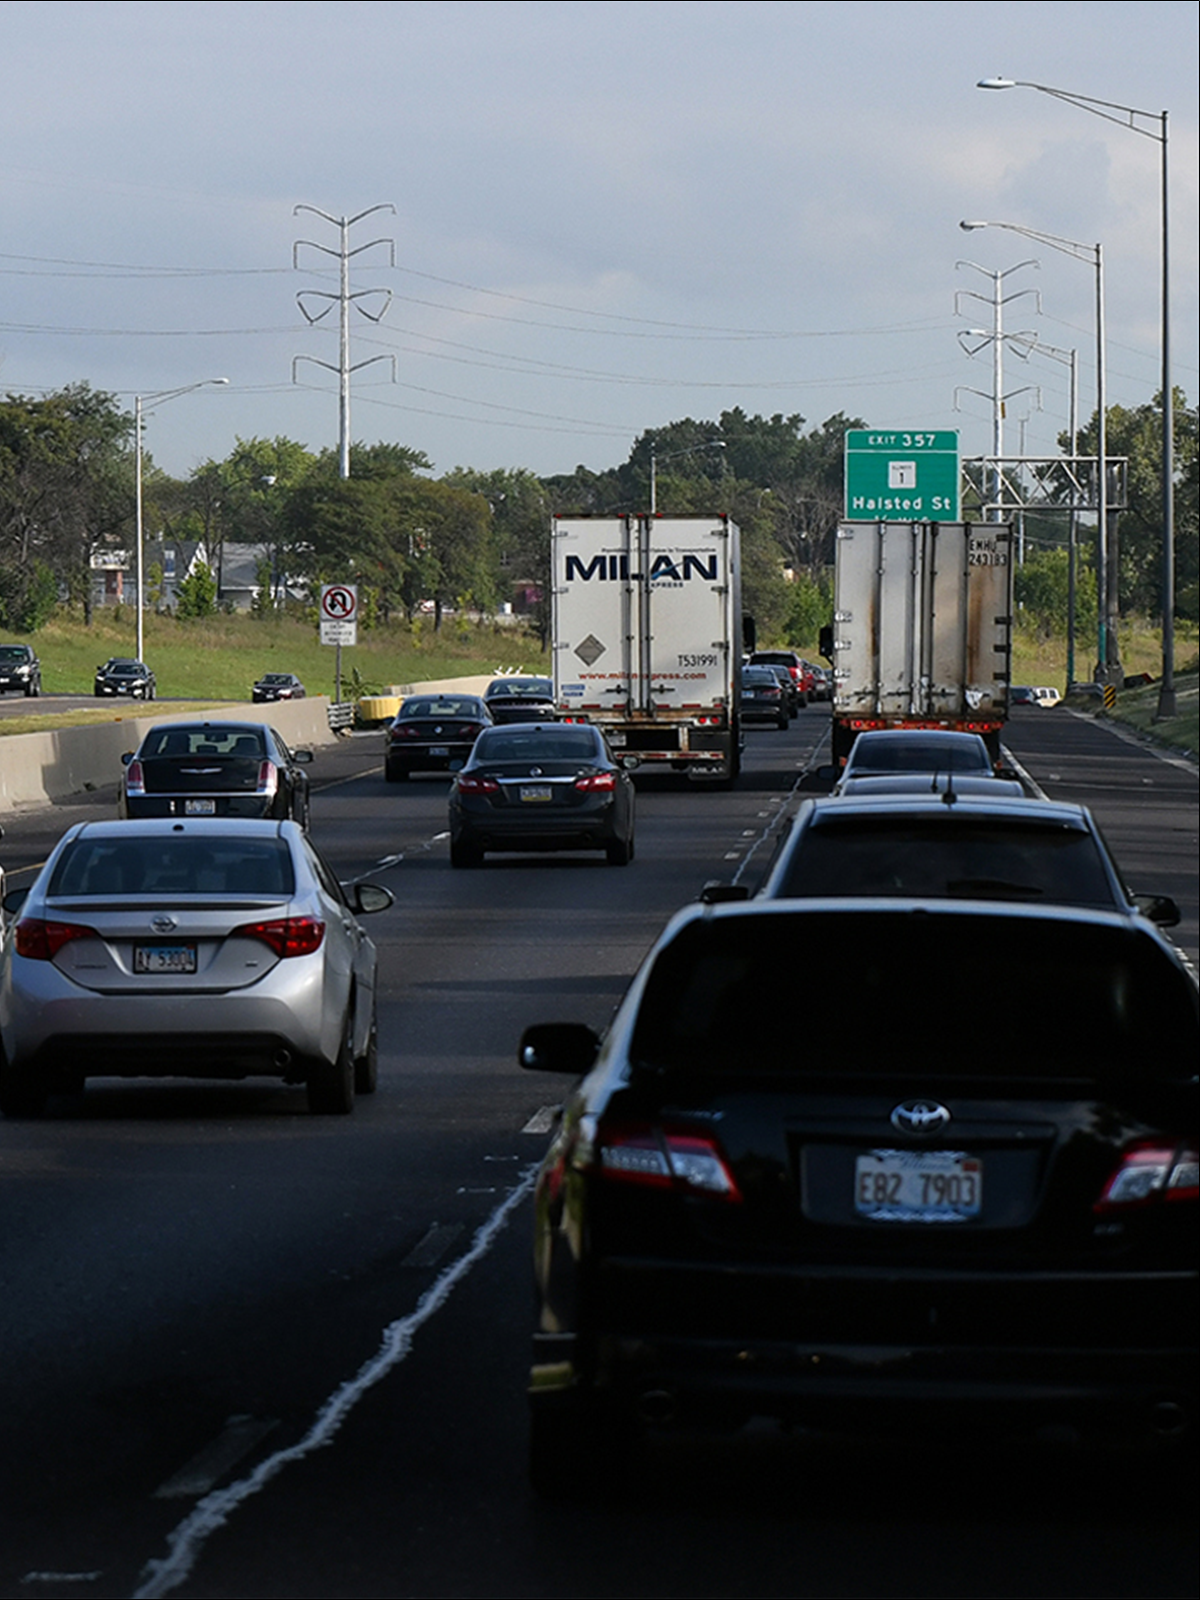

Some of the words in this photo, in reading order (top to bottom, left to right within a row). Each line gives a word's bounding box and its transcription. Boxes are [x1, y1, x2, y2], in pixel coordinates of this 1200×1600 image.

[868, 435, 896, 445] EXIT
[902, 434, 936, 447] 357
[899, 472, 904, 484] 1
[853, 496, 922, 510] Halsted
[931, 496, 951, 510] St
[970, 539, 997, 553] EMHU
[566, 555, 718, 581] MILAN
[859, 1172, 902, 1205] E82
[920, 1173, 976, 1207] 7903
